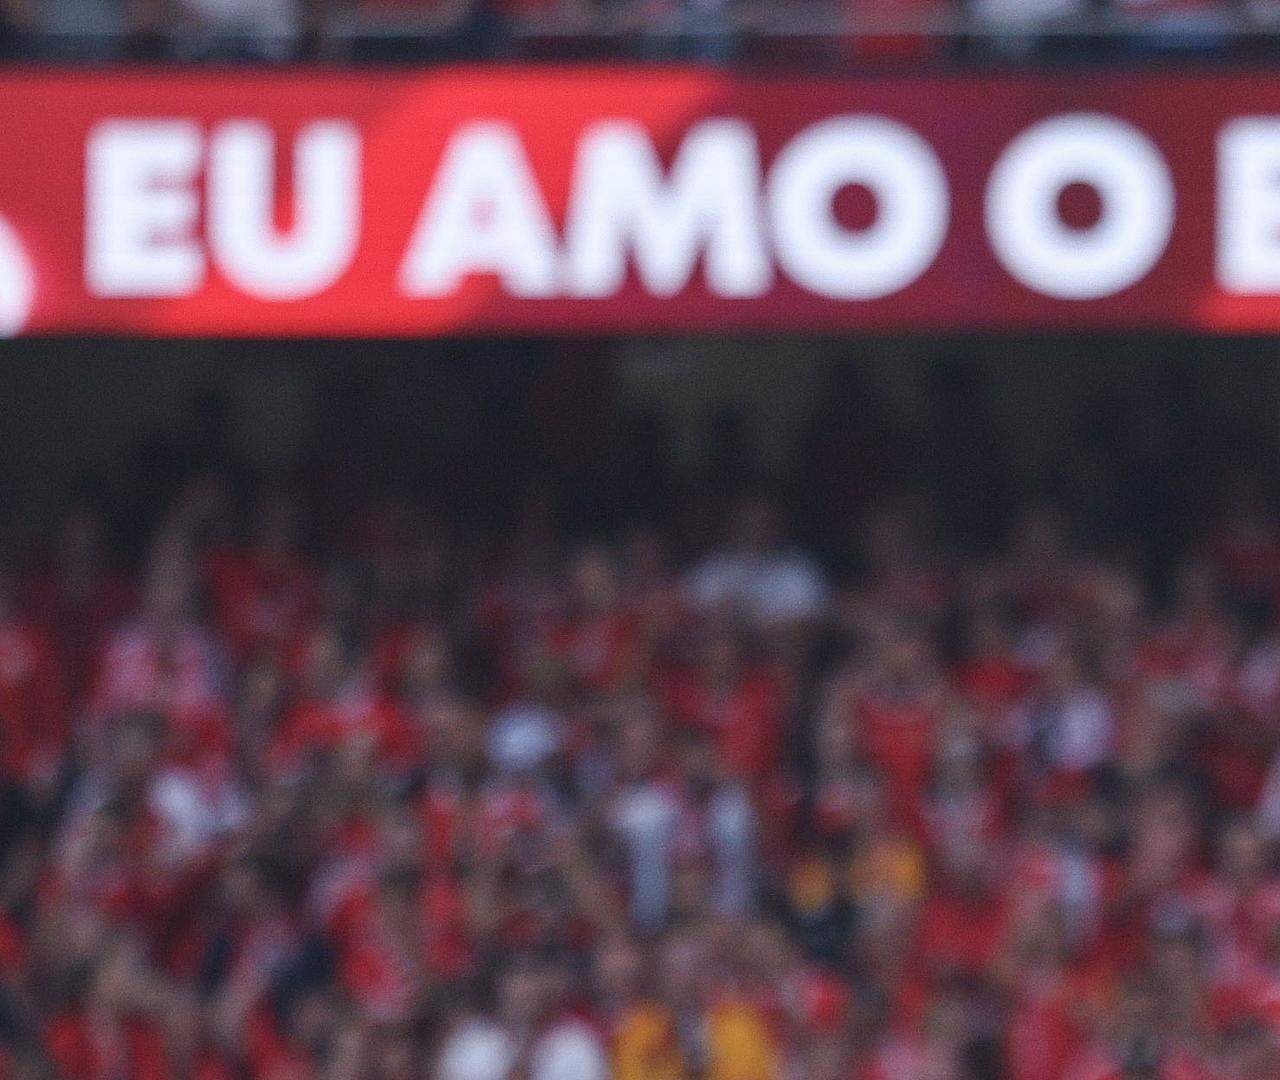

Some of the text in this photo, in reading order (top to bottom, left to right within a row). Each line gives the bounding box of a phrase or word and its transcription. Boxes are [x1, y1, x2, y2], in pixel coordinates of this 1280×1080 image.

[83, 116, 364, 301] EU
[398, 111, 951, 302] AMO
[983, 110, 1176, 302] O
